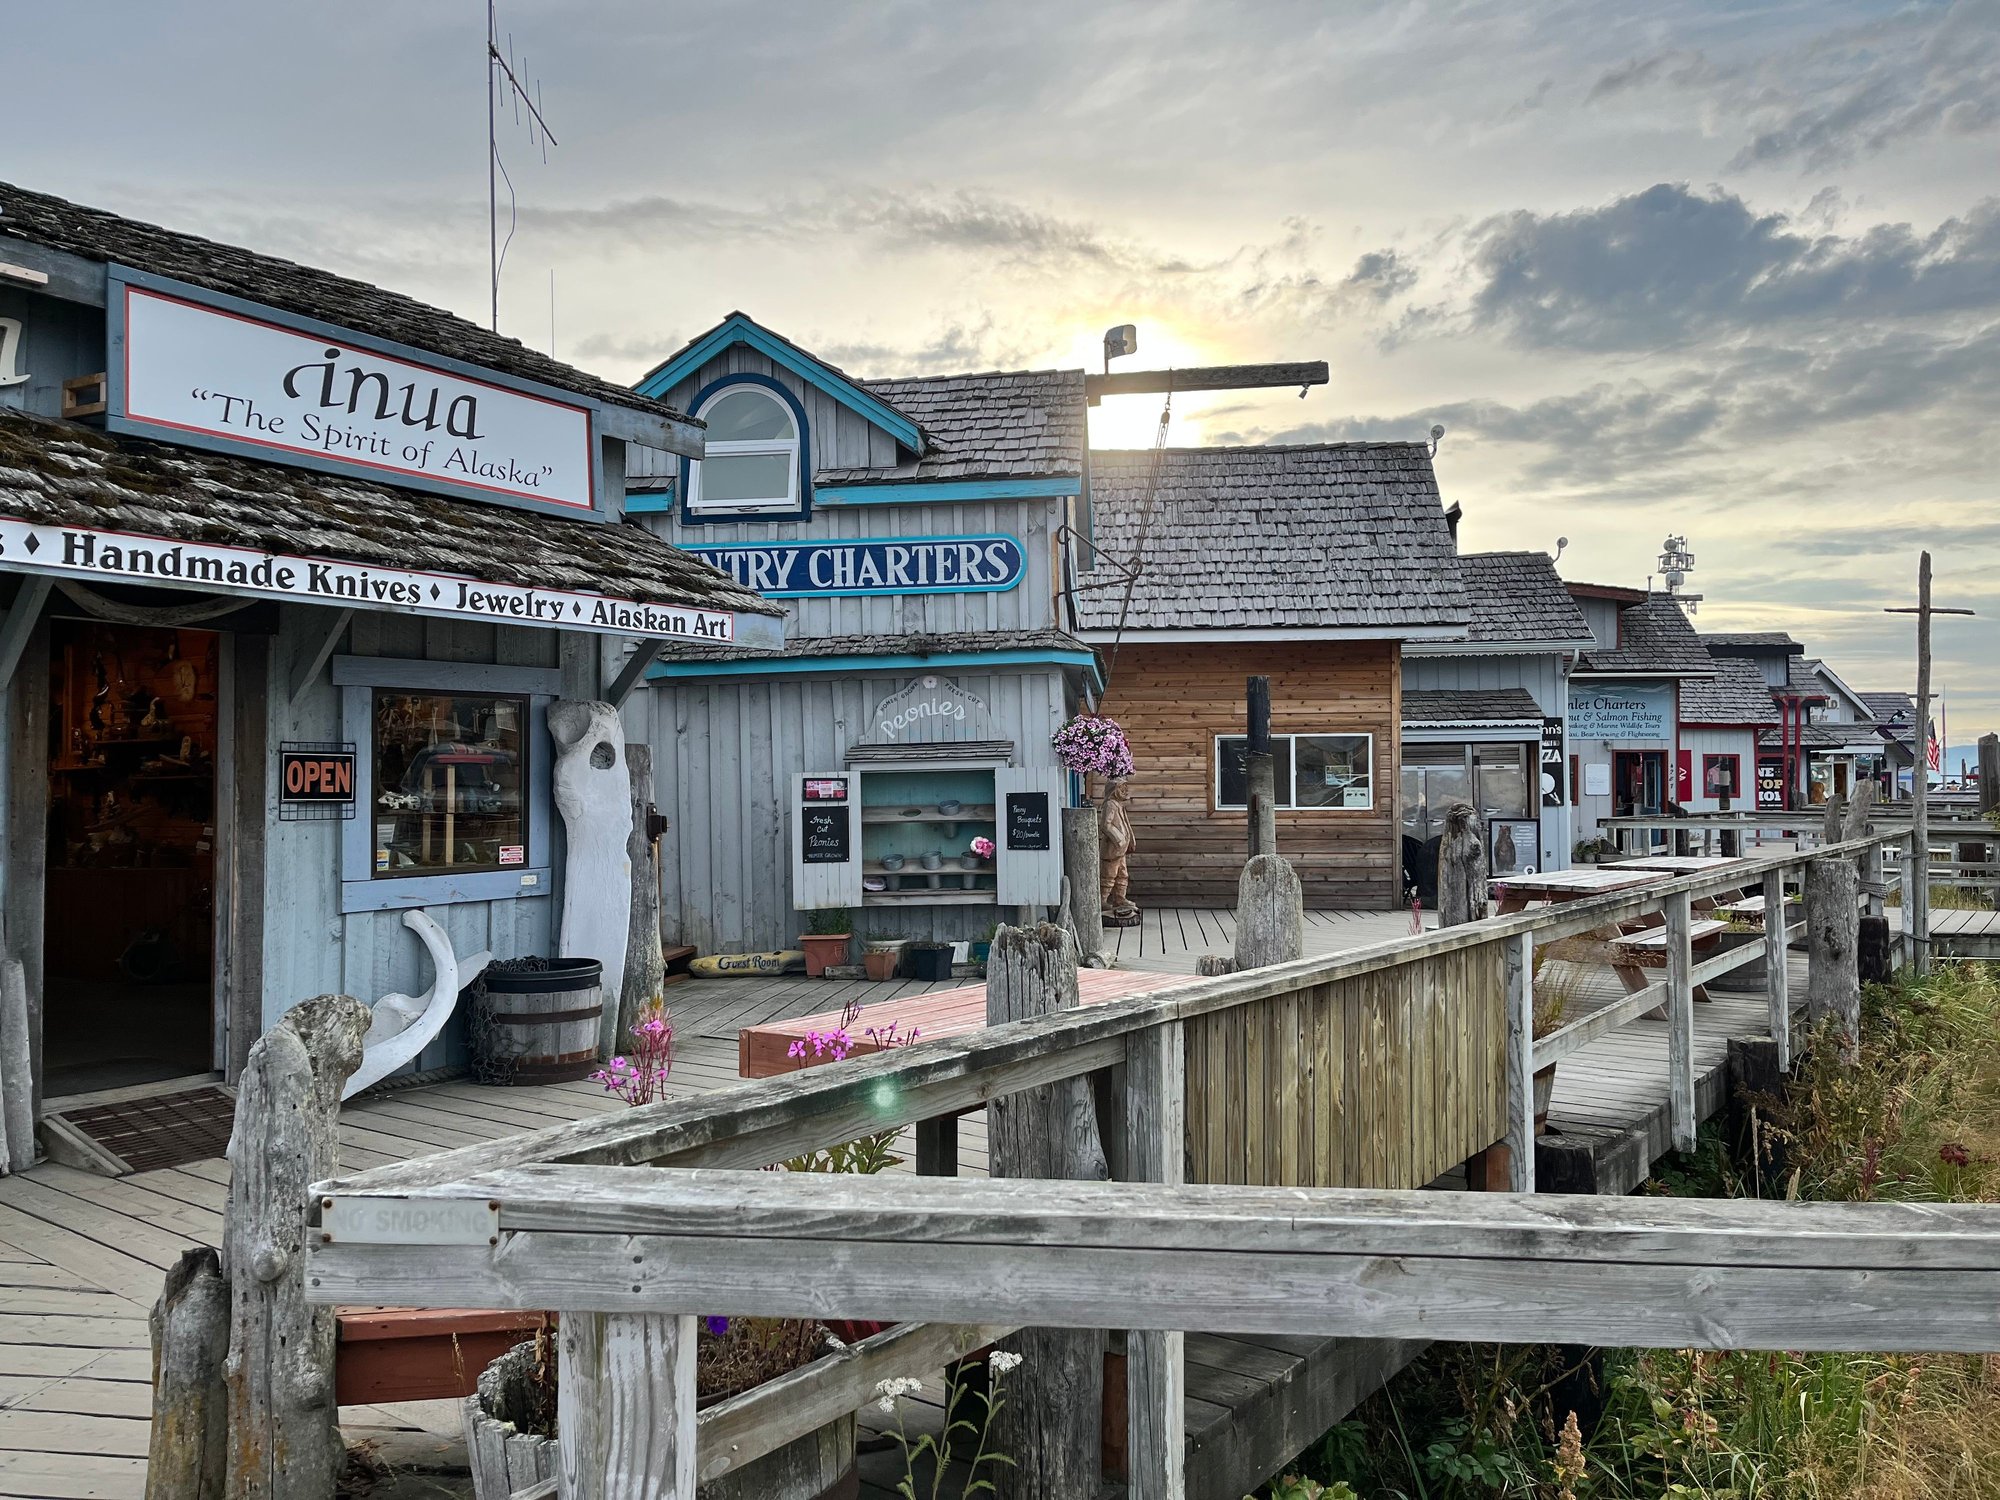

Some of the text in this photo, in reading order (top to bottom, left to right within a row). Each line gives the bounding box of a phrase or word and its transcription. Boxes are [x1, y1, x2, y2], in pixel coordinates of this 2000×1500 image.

[283, 348, 485, 440] inua
[301, 413, 391, 456] Spirit
[402, 441, 434, 469] of
[695, 542, 1010, 590] NTRY CHARTERS
[61, 531, 728, 638] Handmade Knives Jewelry Alaskan Art
[967, 695, 981, 705] CUT
[1568, 697, 1646, 710] nlet Charters
[1583, 711, 1593, 722] &
[1595, 711, 1629, 722] Salmon
[1631, 711, 1662, 723] Fishing
[1541, 724, 1562, 735] nn's
[1568, 722, 1588, 730] yaking
[1620, 721, 1643, 730] Wildlife
[1580, 730, 1596, 738] Bear
[1596, 730, 1620, 739] Viewing
[1620, 730, 1627, 738] &
[286, 760, 351, 793] OPEN
[1757, 767, 1774, 777] NE
[809, 815, 834, 825] Fresh
[808, 834, 840, 847] Peonies
[718, 955, 780, 970] Guest Room
[334, 1207, 489, 1234] NO SMOKING
